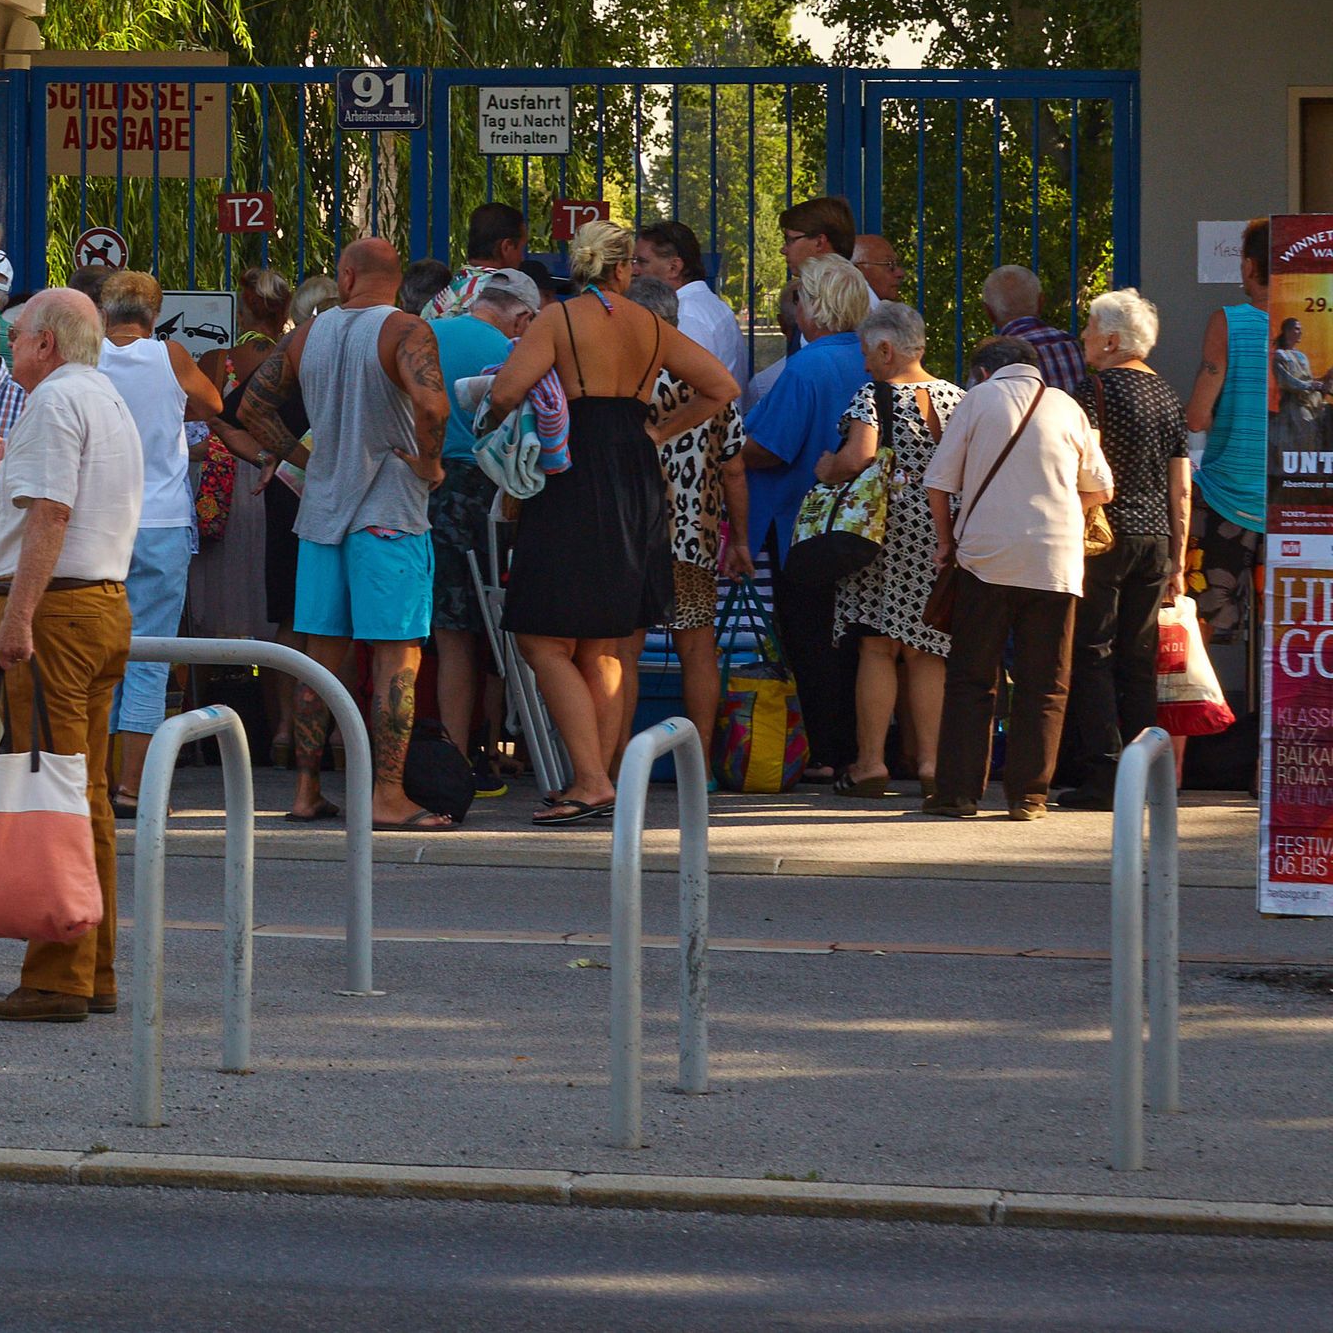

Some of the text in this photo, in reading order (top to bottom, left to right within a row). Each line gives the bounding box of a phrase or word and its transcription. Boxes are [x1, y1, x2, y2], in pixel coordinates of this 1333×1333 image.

[351, 72, 410, 108] 91
[486, 94, 562, 111] Ausfahrt
[482, 115, 506, 130] Tag
[63, 116, 190, 151] AUSGABE
[490, 131, 558, 145] freihalten
[227, 198, 264, 227] T2
[1304, 297, 1332, 312] 29.
[1277, 727, 1318, 745] JAZZ
[1301, 856, 1327, 876] BIS
